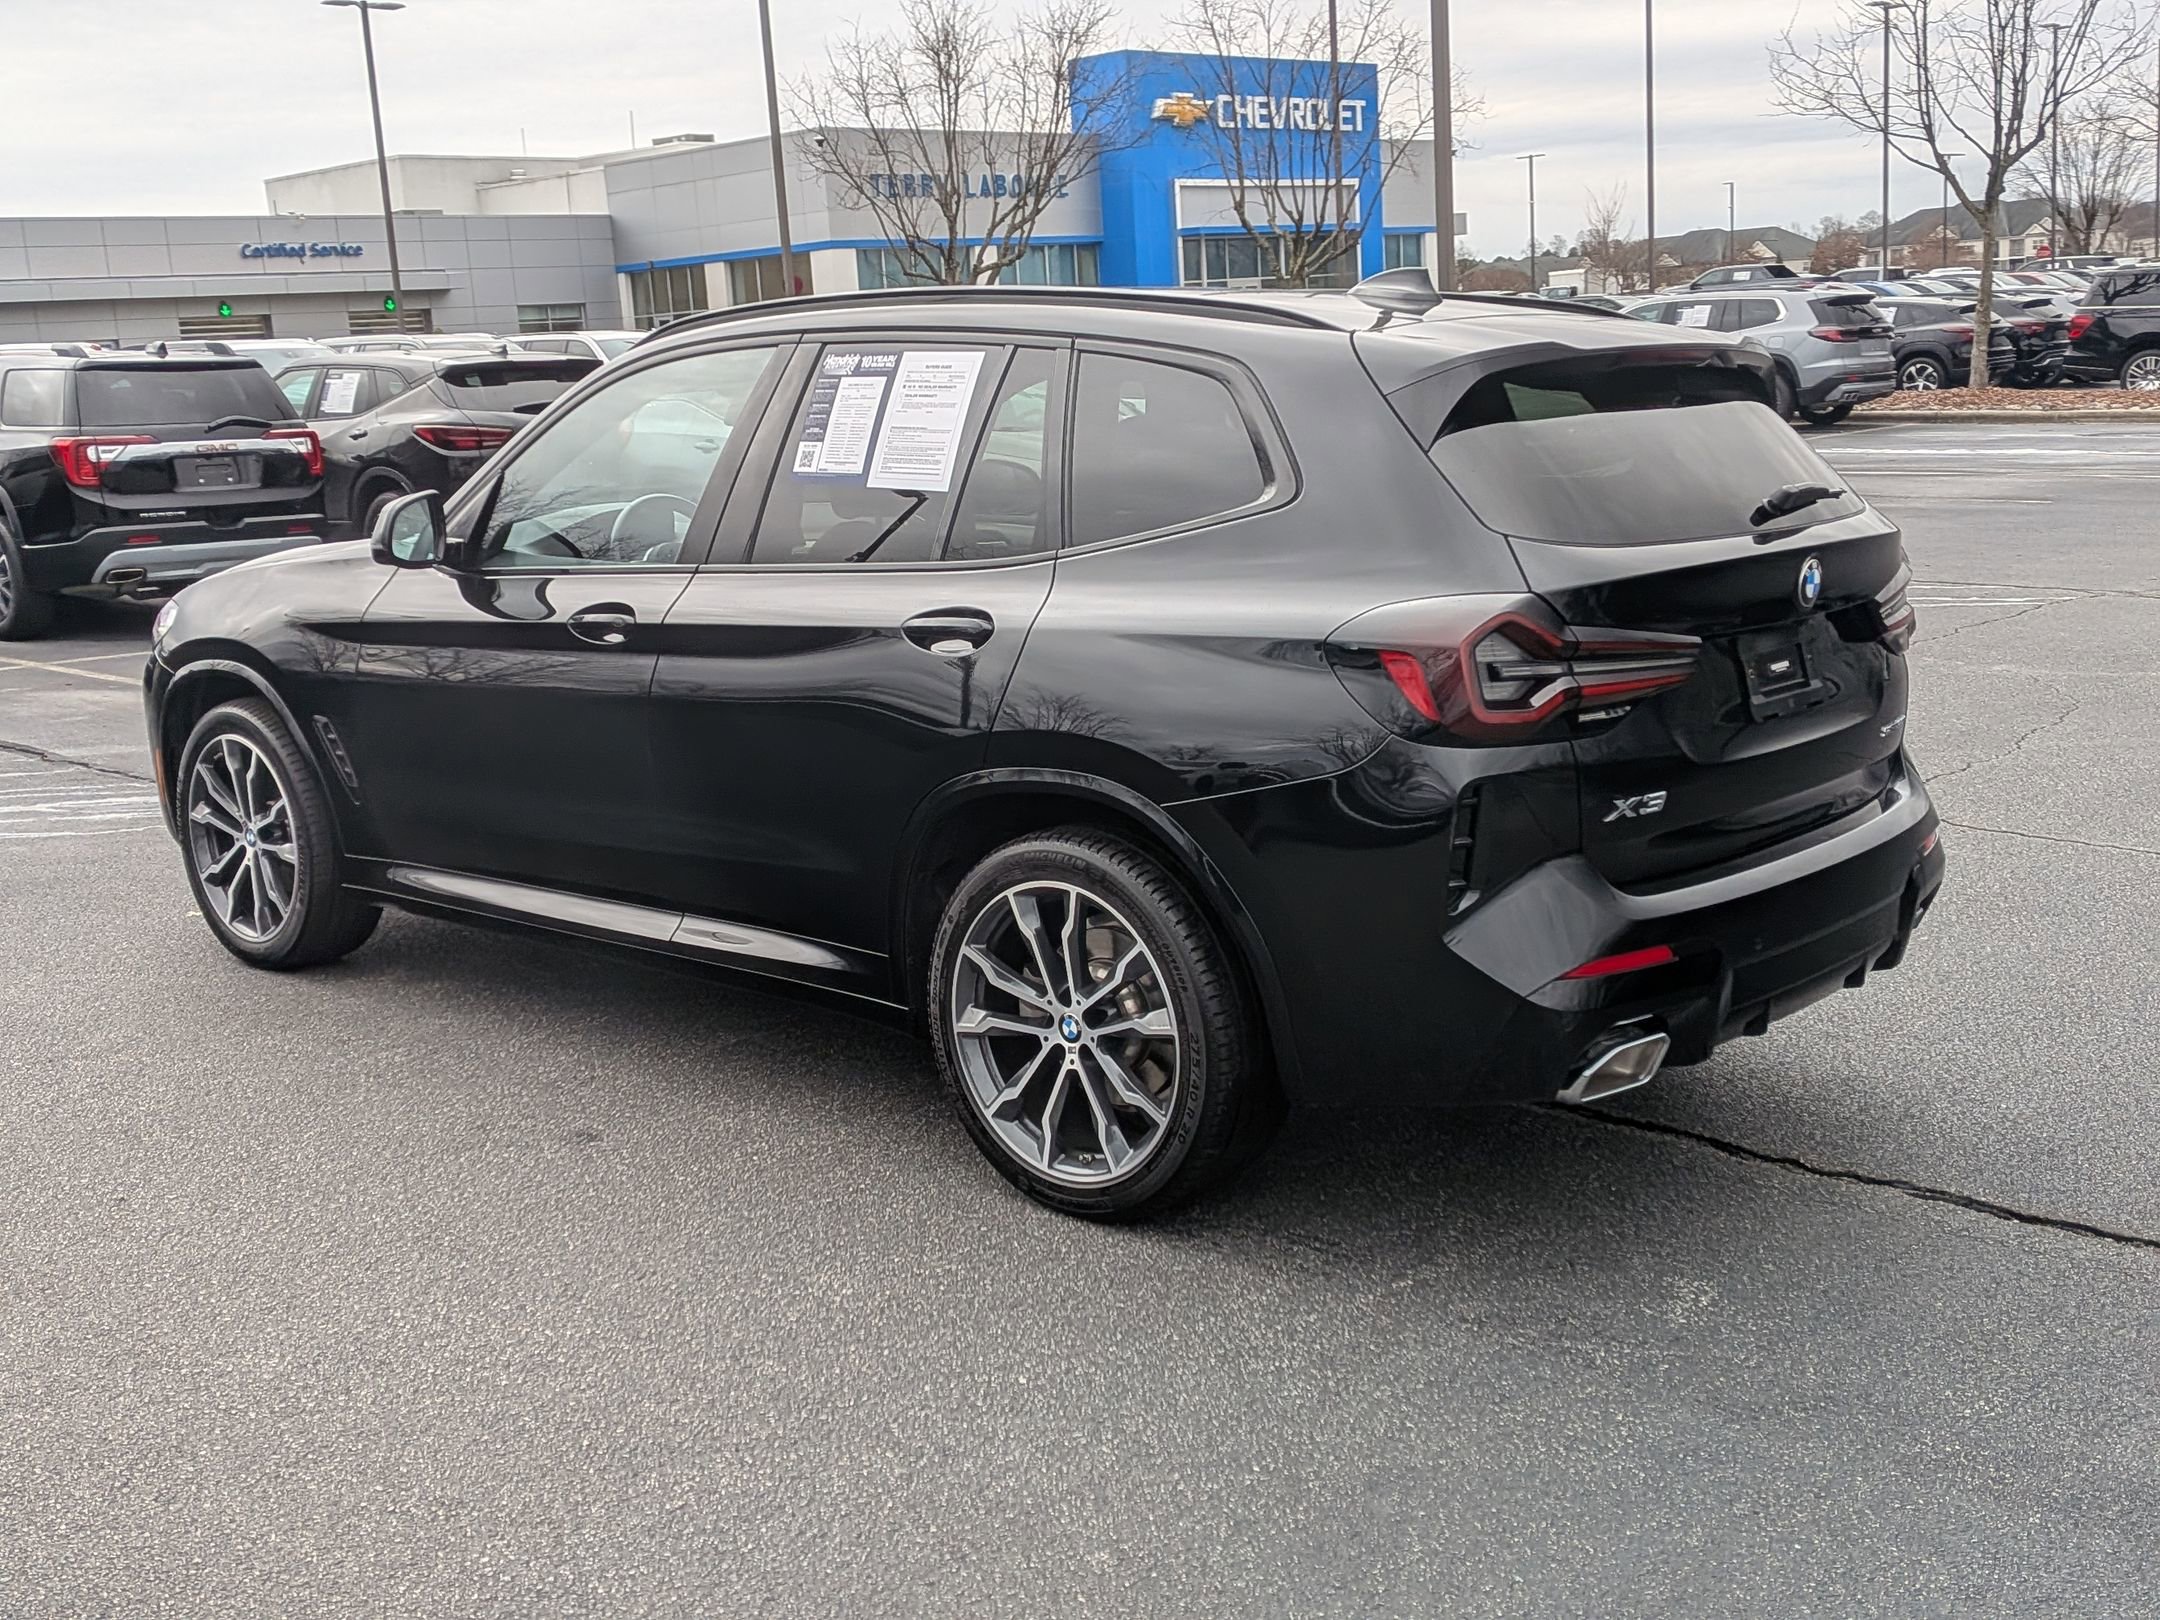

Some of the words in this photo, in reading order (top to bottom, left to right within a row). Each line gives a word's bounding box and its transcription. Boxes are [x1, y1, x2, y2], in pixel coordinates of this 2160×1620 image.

[1216, 94, 1367, 132] CHEVROLET
[963, 173, 1069, 199] LABOE
[241, 242, 306, 258] Certified
[309, 242, 364, 257] Service
[195, 443, 239, 453] GMC
[1602, 789, 1668, 823] X3
[1023, 851, 1087, 870] MICHELIN
[930, 965, 940, 1007] Sport
